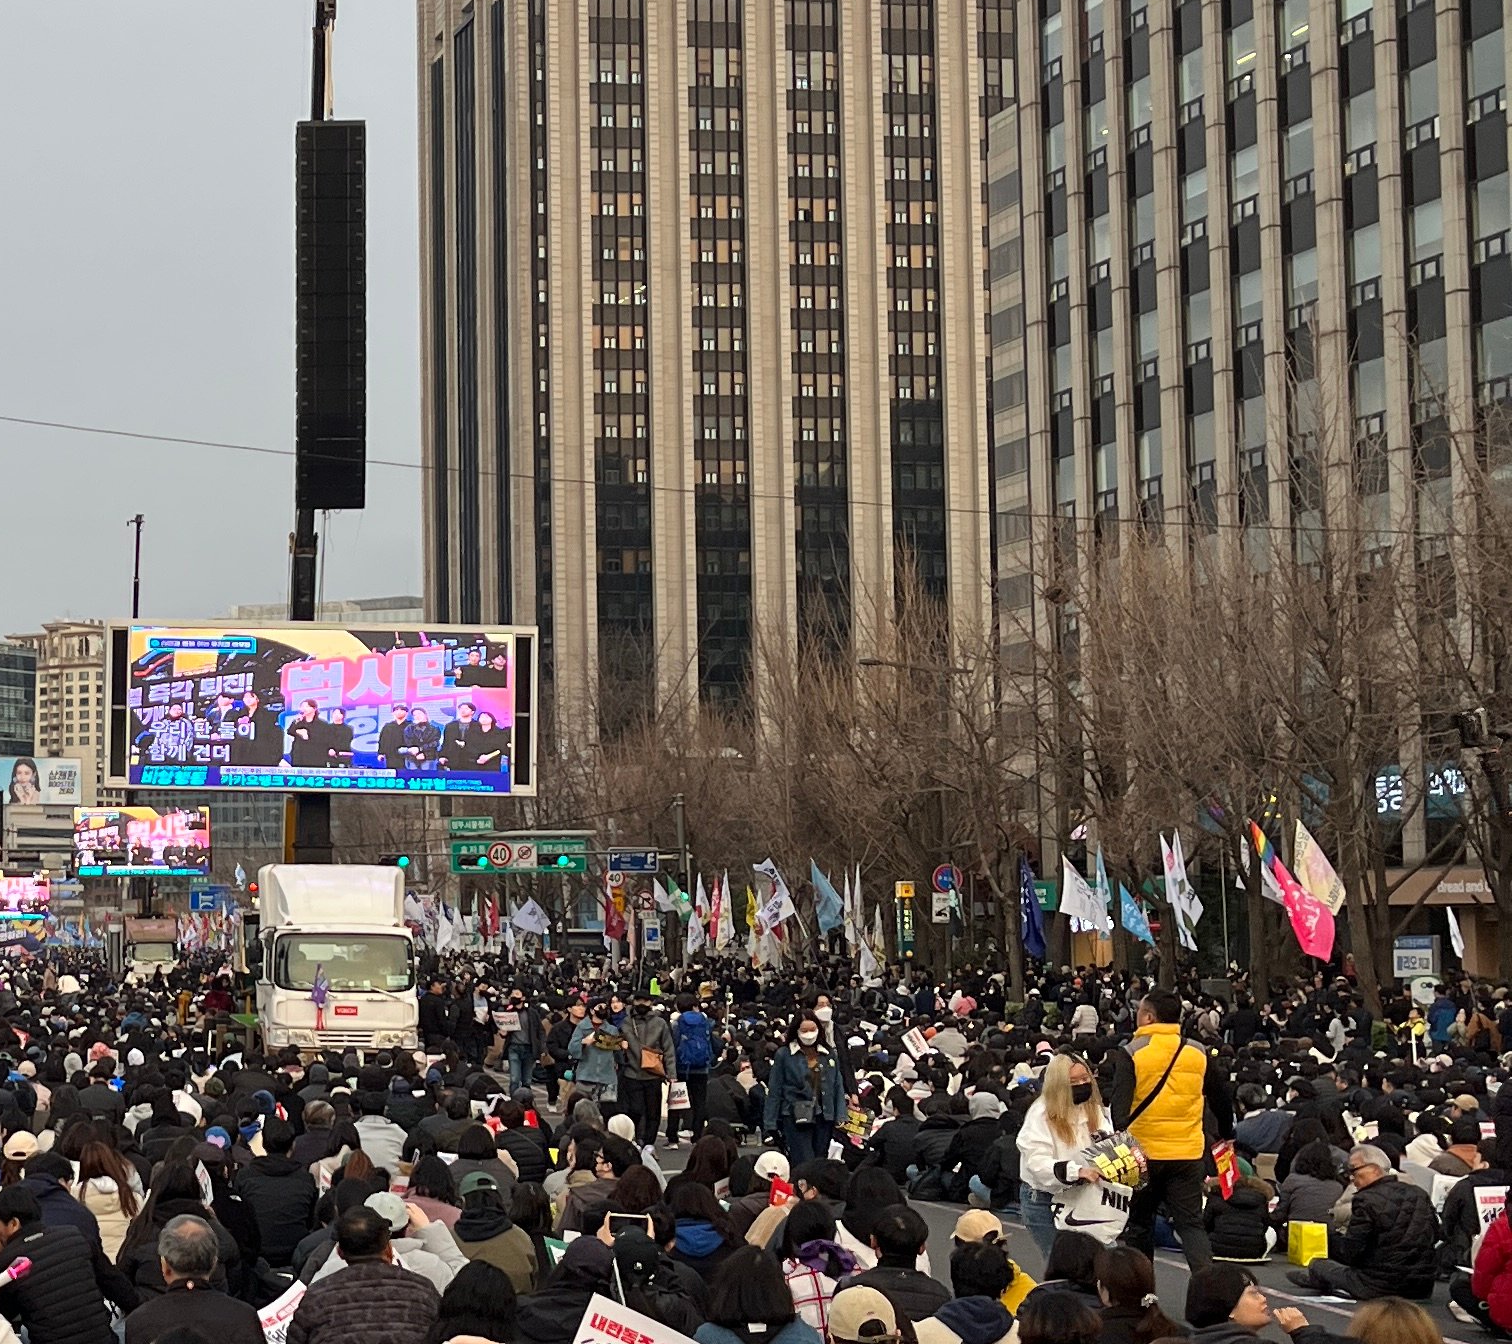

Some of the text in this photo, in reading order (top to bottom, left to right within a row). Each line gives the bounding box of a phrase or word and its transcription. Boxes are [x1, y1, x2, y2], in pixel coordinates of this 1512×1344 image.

[148, 679, 195, 704] 즉각
[198, 672, 254, 697] 퇴진!
[287, 649, 446, 712] 범시민
[148, 743, 187, 763] 함께
[492, 847, 507, 861] 40
[608, 873, 621, 883] 40
